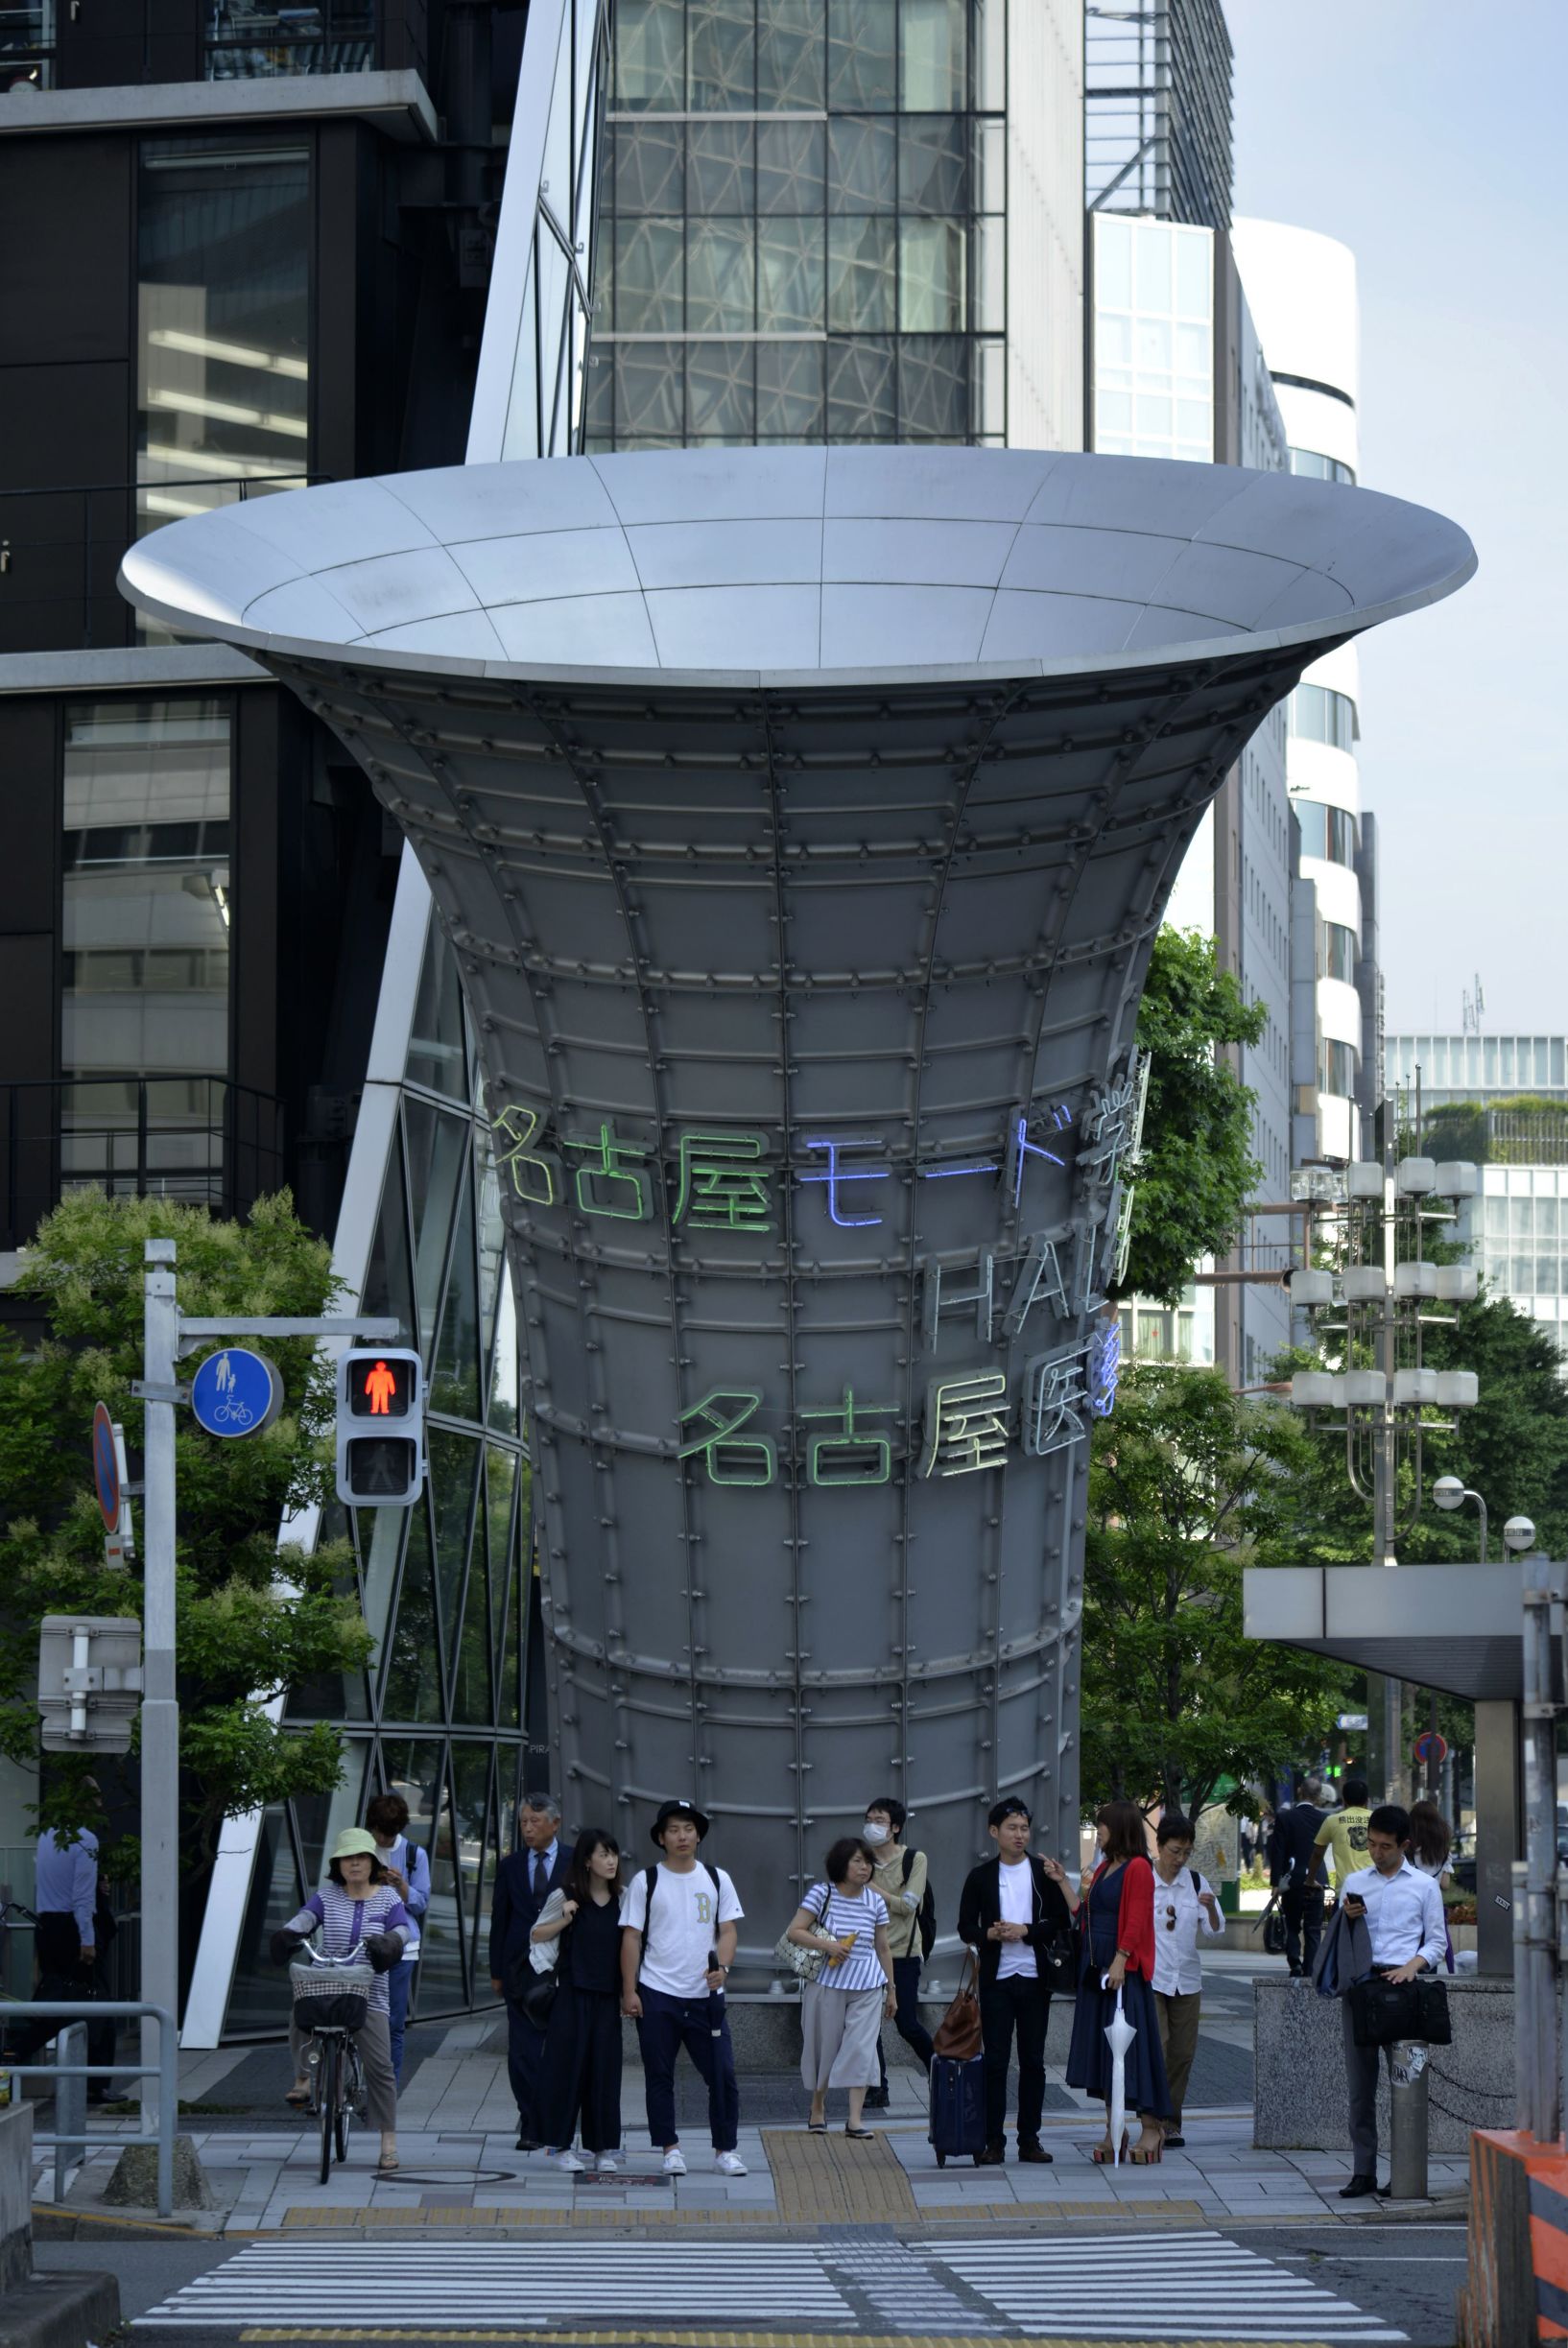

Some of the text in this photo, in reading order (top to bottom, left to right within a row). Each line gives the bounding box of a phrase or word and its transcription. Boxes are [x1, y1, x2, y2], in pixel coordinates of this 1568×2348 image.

[492, 1046, 1152, 1232] 名古屋モード学
[694, 1891, 711, 1924] B
